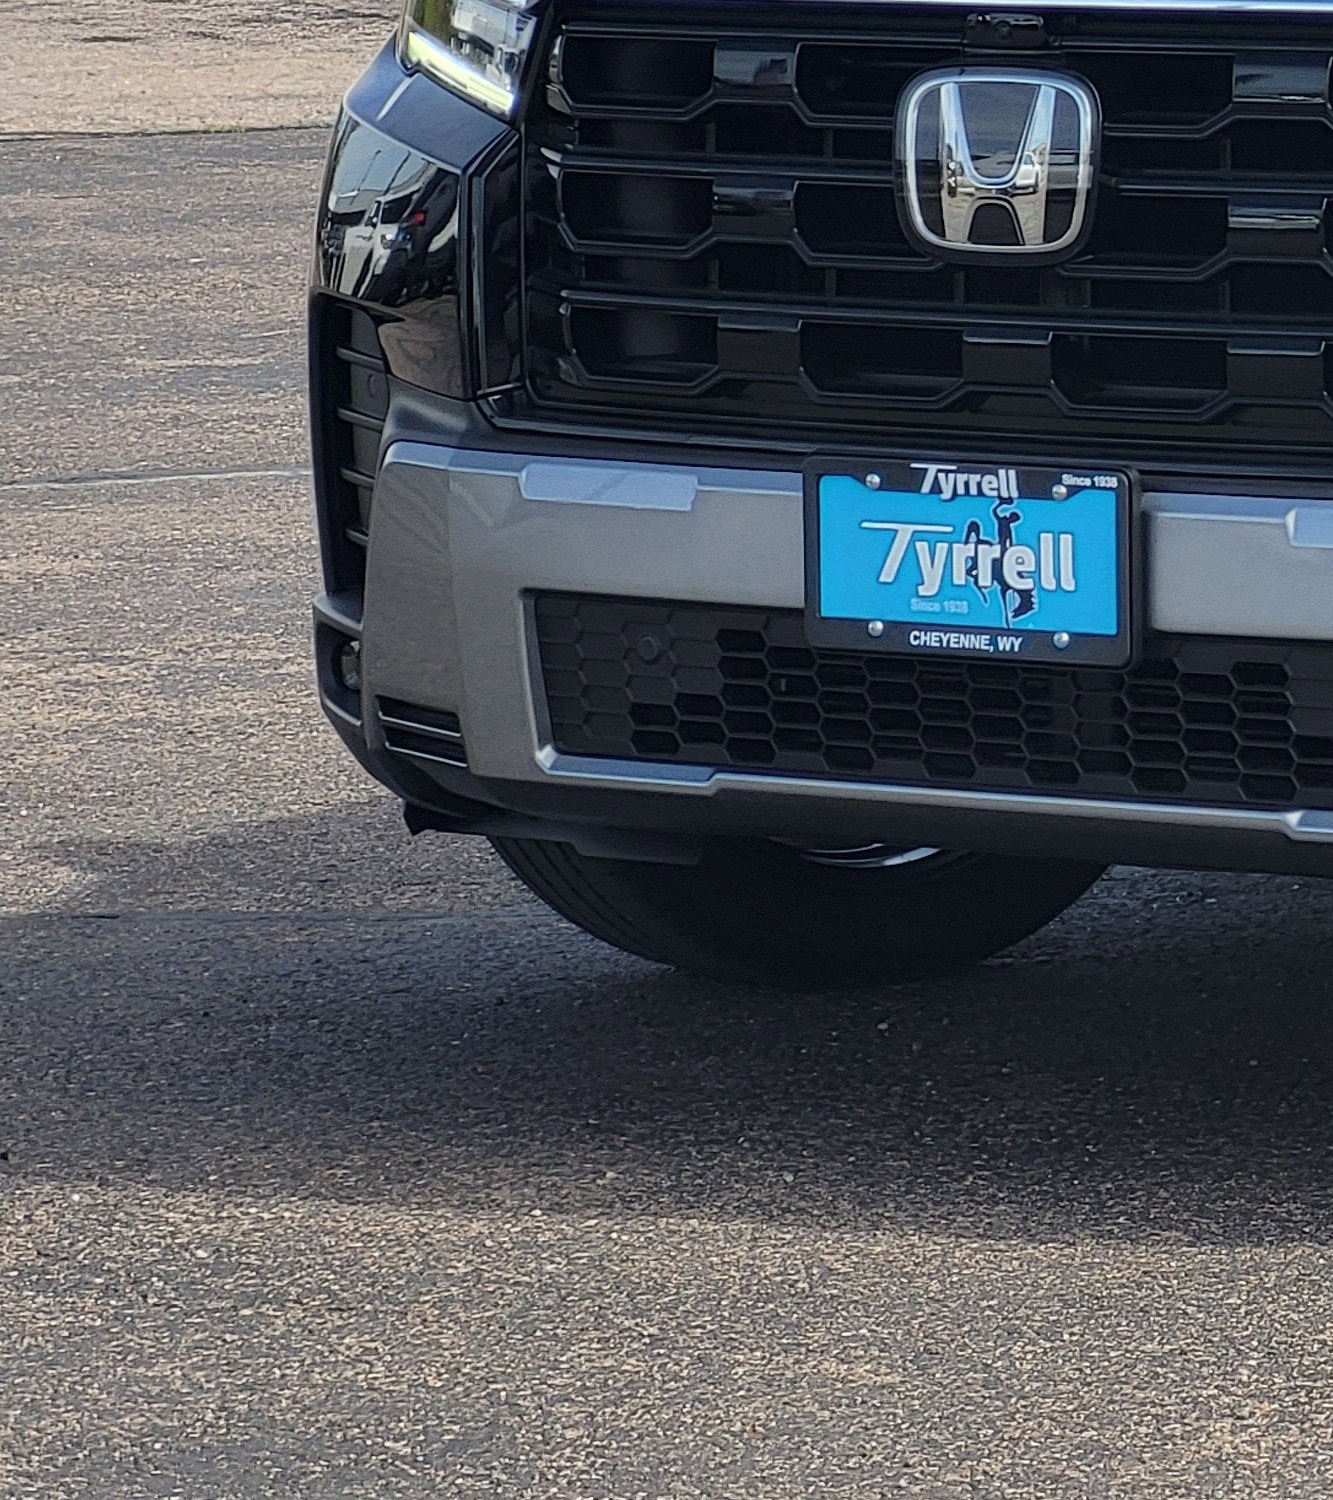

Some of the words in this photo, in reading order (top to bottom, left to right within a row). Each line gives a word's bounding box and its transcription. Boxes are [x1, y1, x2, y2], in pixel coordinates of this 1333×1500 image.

[909, 462, 1019, 501] Tyrrell
[1061, 473, 1092, 488] Since
[1093, 475, 1119, 489] 1938
[860, 520, 1077, 597] Tyrrell
[909, 629, 994, 653] CHEYENNE,
[997, 636, 1023, 653] WY
